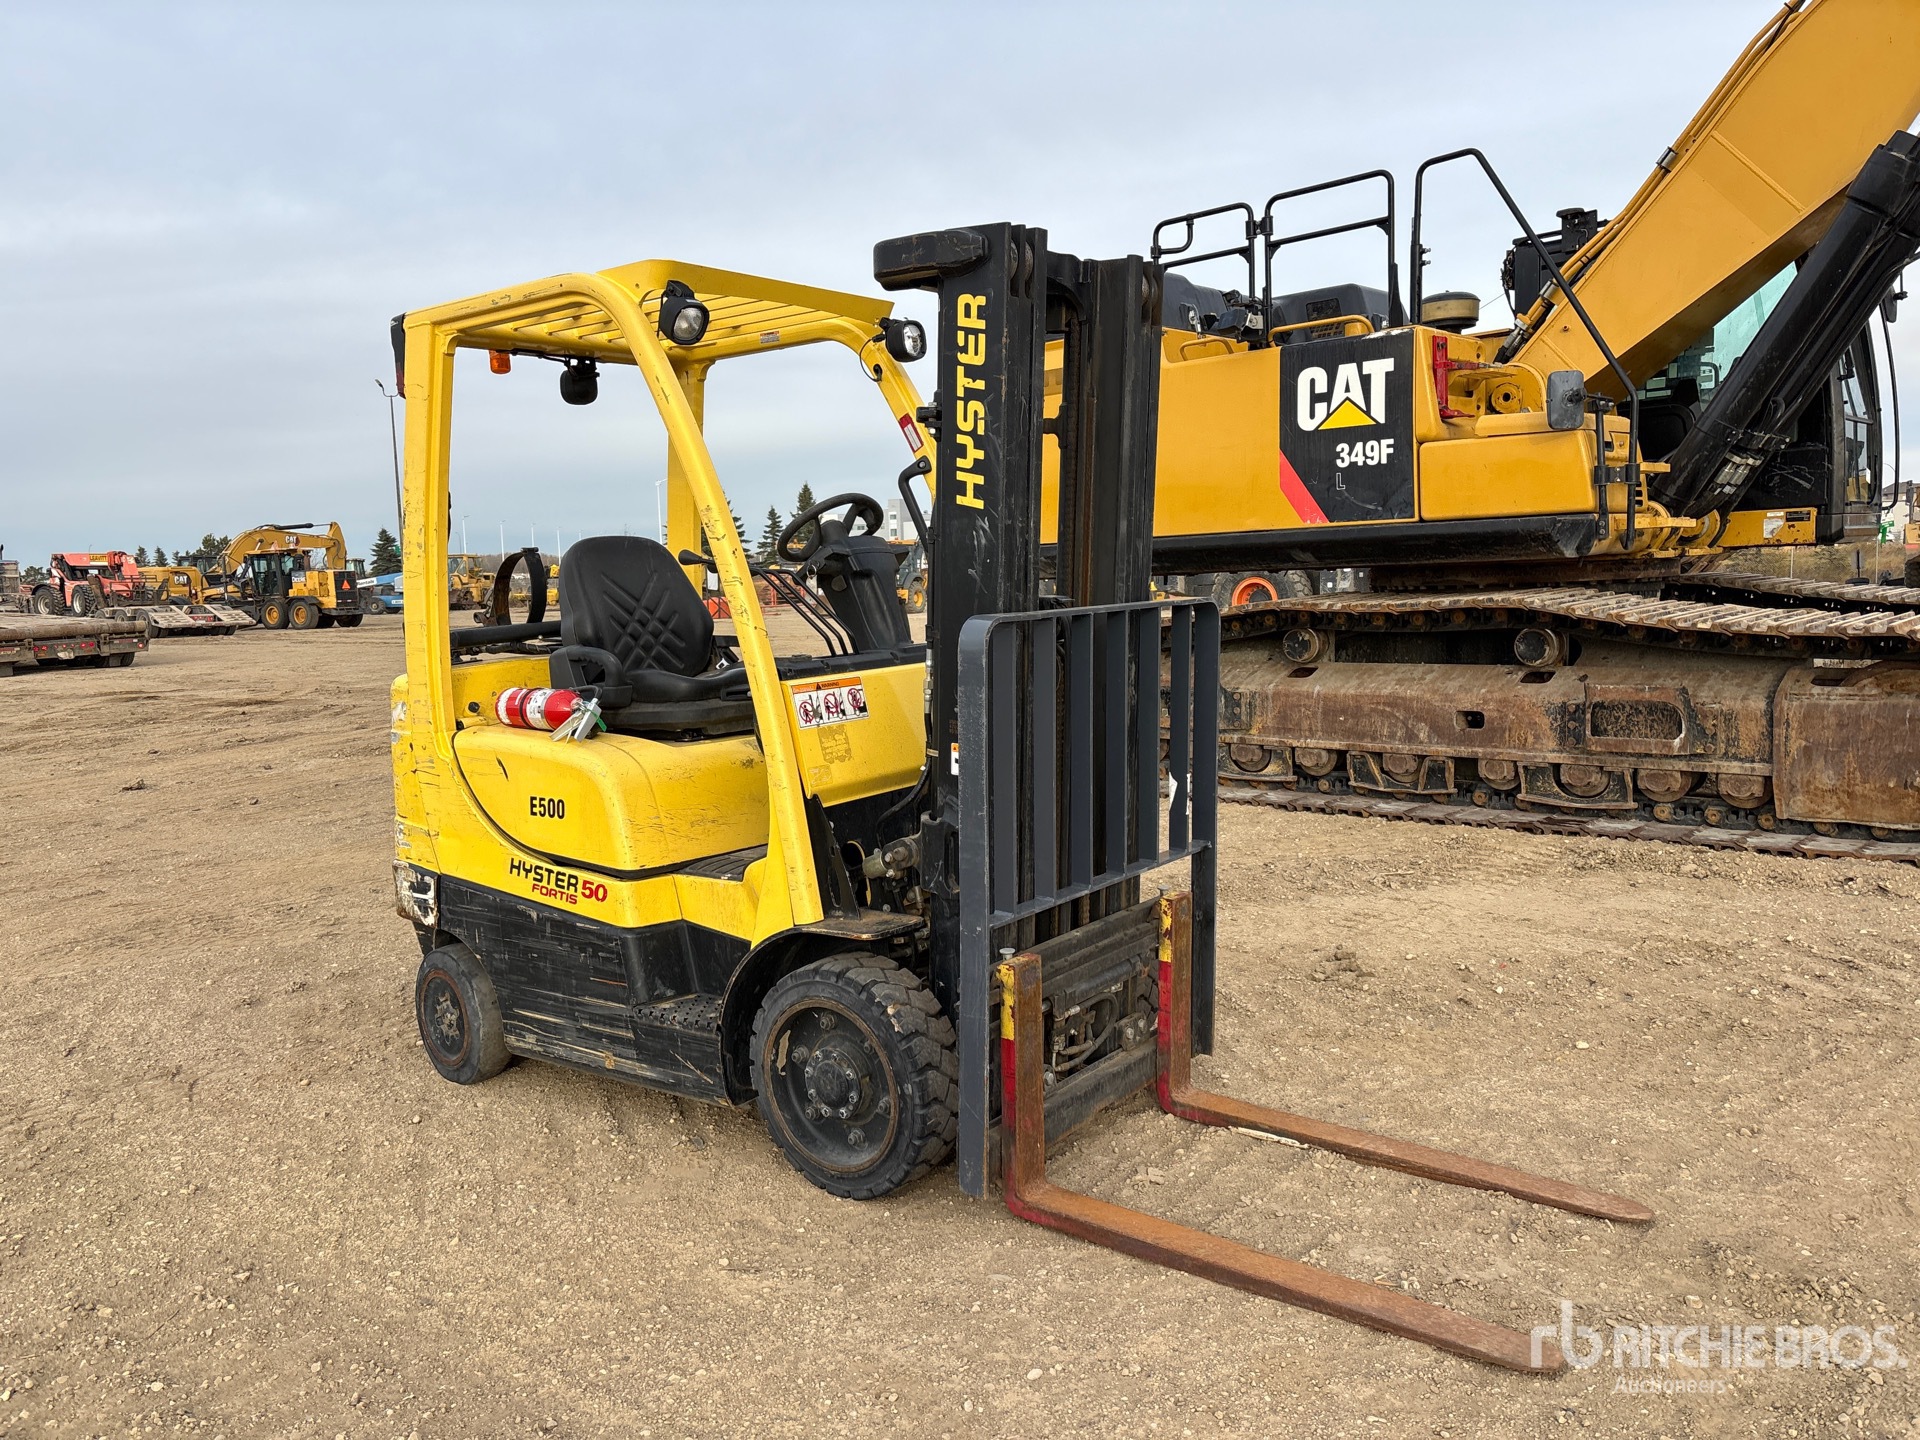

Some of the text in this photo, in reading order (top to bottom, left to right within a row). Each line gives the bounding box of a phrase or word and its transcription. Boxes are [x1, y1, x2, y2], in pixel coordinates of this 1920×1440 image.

[956, 293, 987, 510] HYSTER
[1297, 357, 1395, 432] CAT
[1335, 438, 1395, 468] 349F
[1335, 472, 1346, 490] L
[285, 535, 297, 544] CAT
[174, 575, 188, 585] CAT
[821, 681, 840, 689] WARNING
[530, 796, 565, 819] E500
[509, 857, 579, 893] HYSTER
[532, 883, 578, 905] FORTIS
[581, 880, 608, 903] 50
